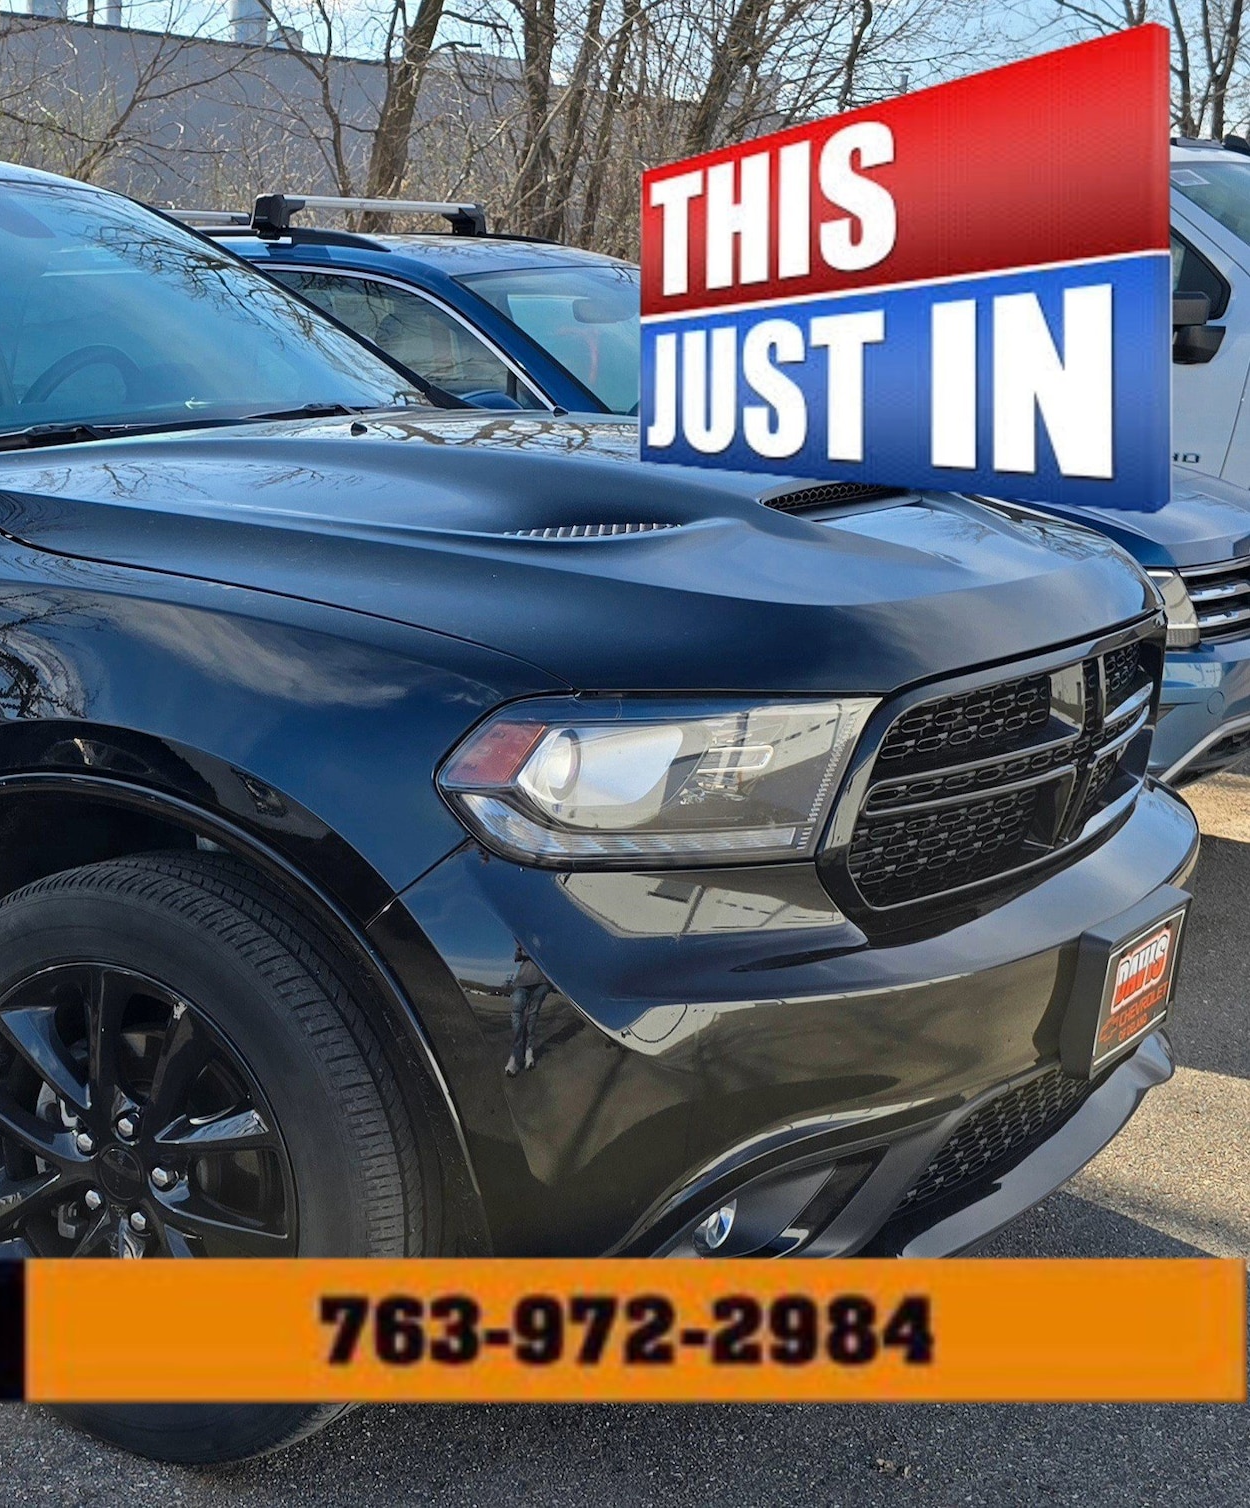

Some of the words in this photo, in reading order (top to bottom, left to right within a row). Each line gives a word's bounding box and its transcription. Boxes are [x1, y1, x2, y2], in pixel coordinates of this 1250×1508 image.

[1113, 933, 1169, 1008] DAVIS
[1119, 981, 1169, 1027] CHEVROLET
[1118, 1028, 1127, 1042] OF
[1127, 1013, 1148, 1037] DELANO
